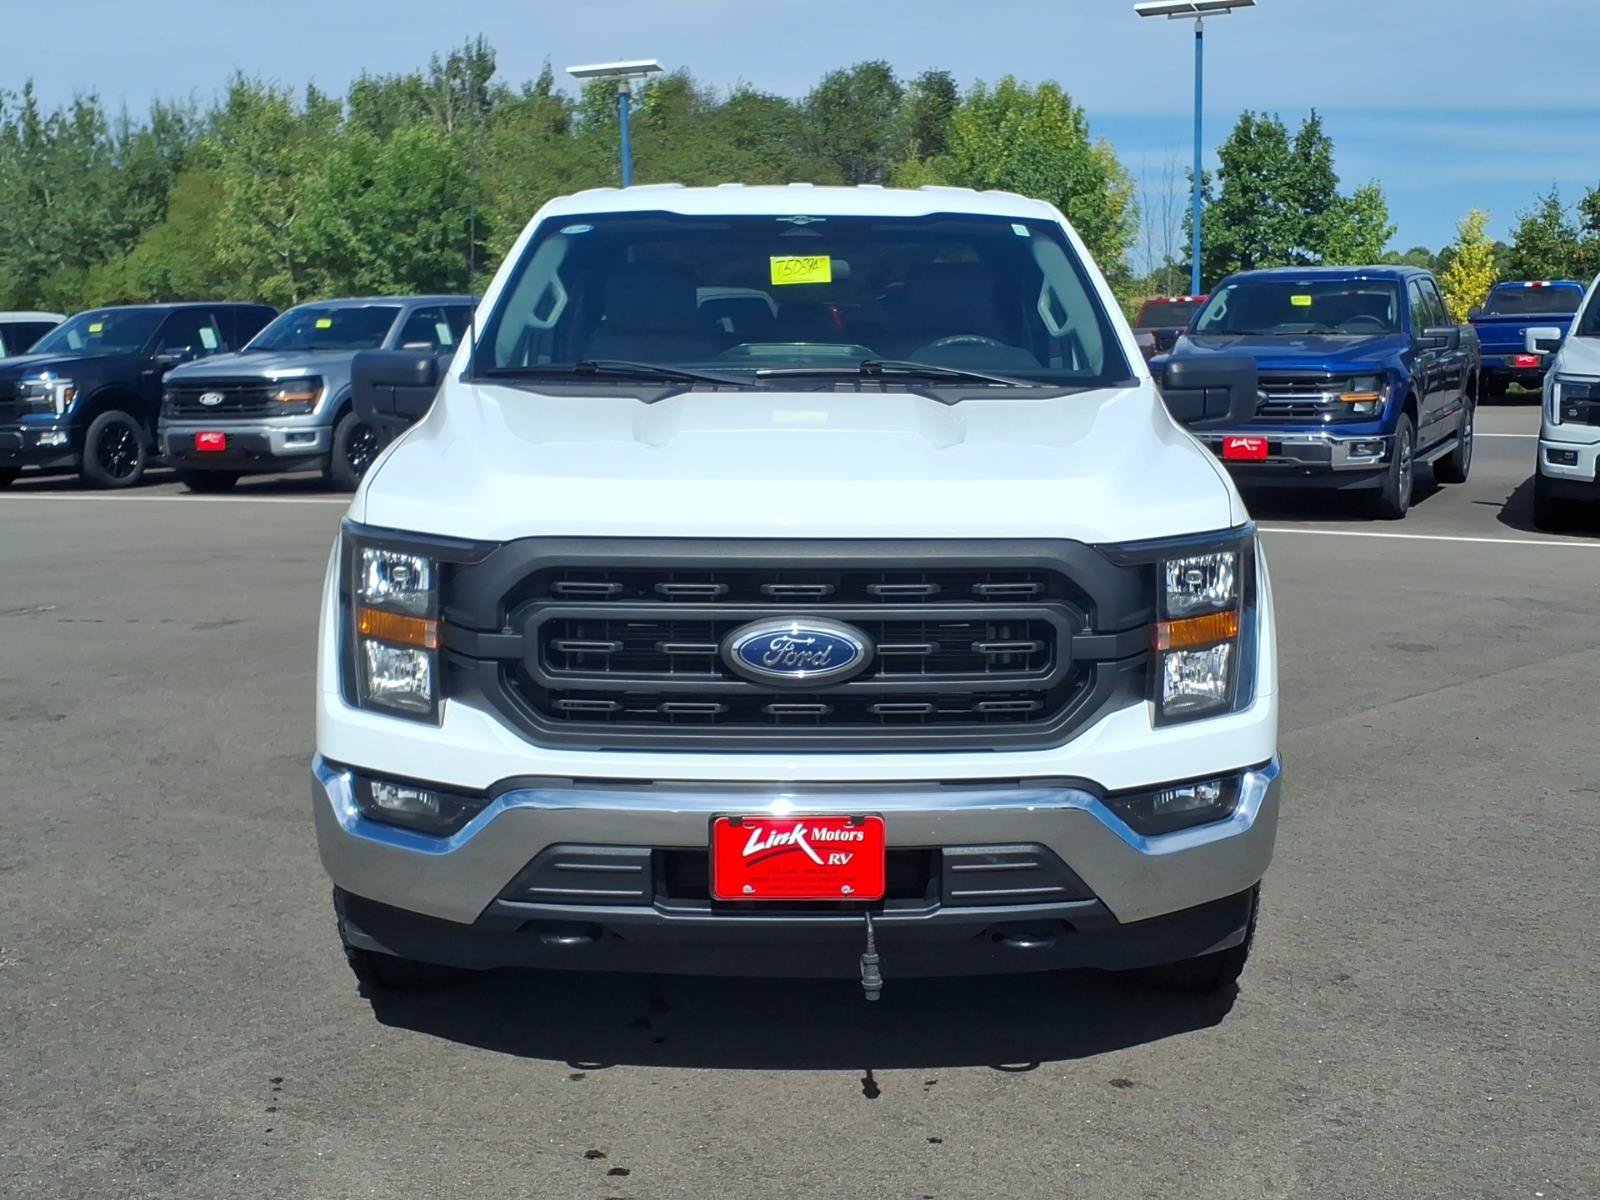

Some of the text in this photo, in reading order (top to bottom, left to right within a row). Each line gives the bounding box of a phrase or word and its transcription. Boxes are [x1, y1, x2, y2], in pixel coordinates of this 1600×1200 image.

[763, 635, 833, 667] Ford
[742, 823, 864, 865] Link Motors
[828, 853, 853, 865] RV
